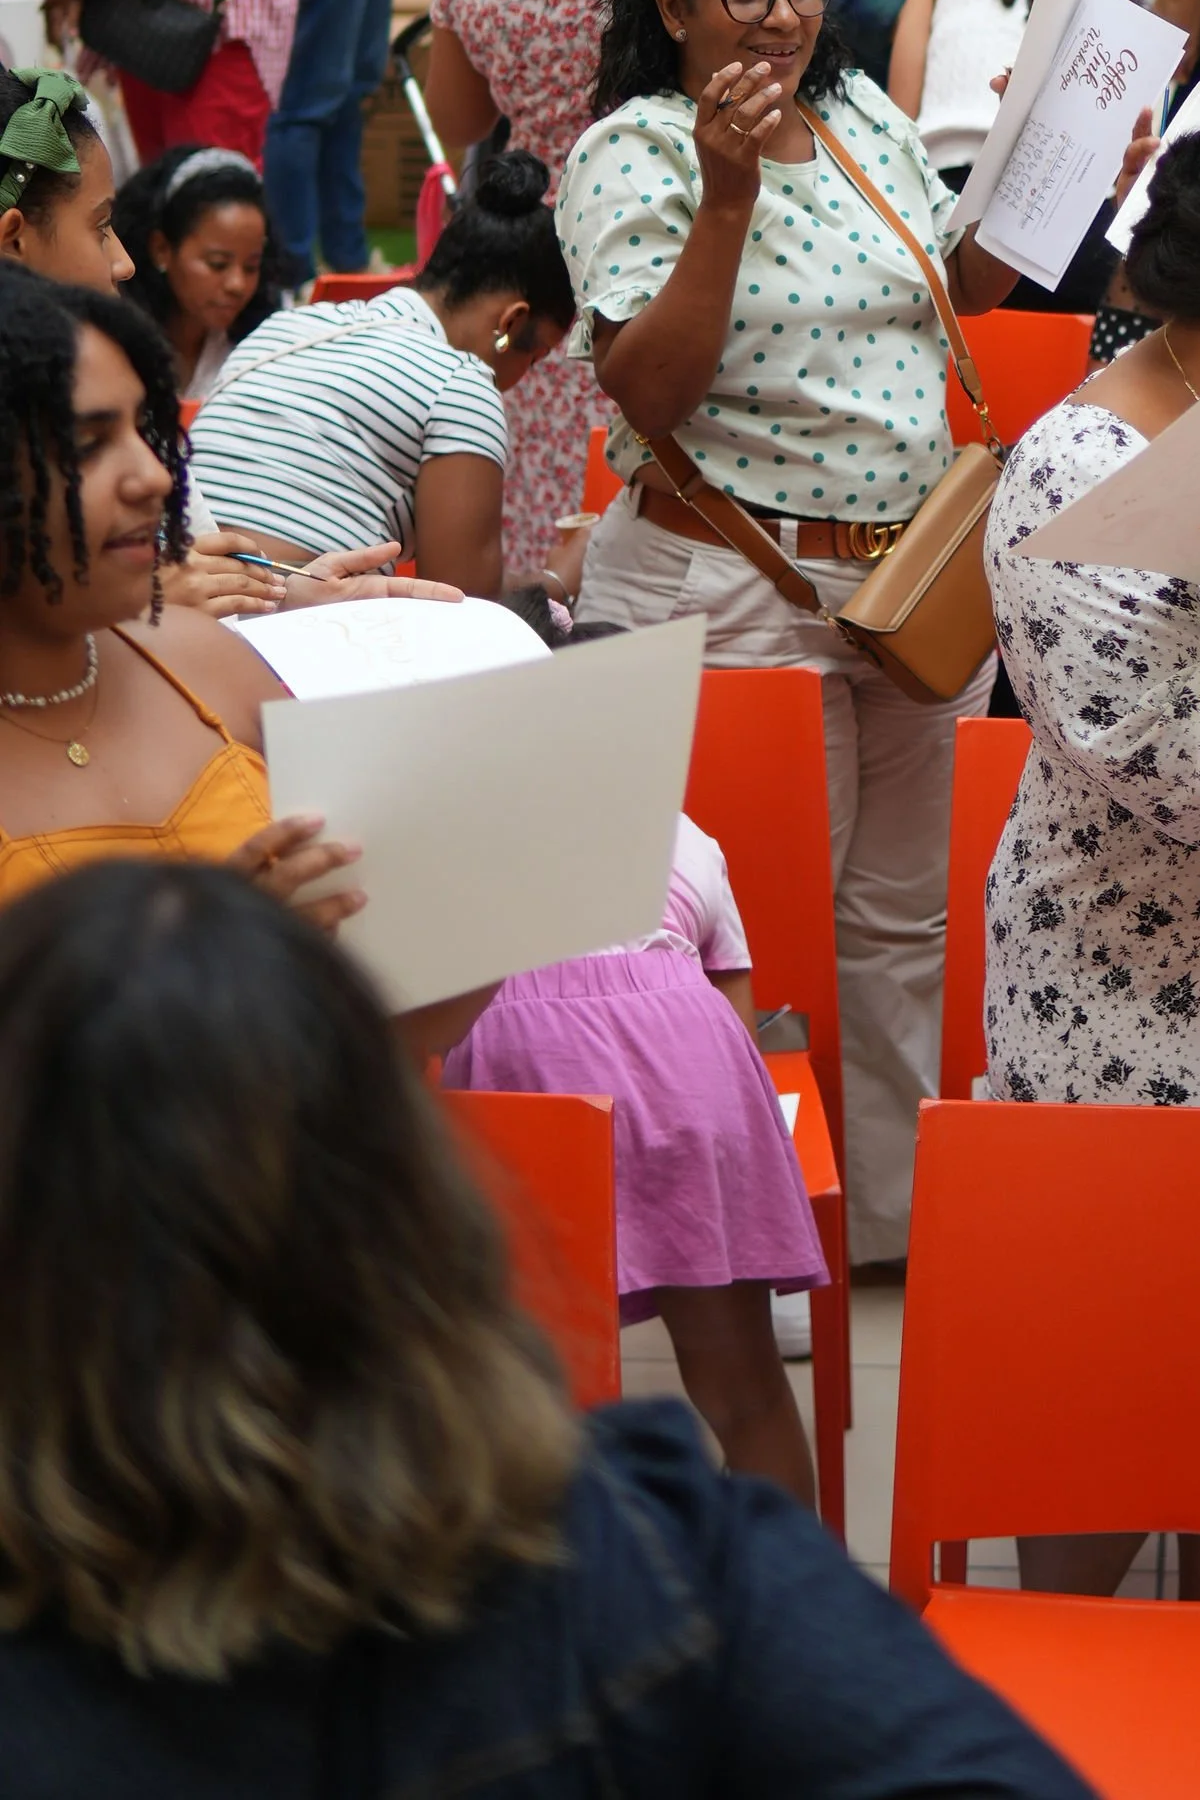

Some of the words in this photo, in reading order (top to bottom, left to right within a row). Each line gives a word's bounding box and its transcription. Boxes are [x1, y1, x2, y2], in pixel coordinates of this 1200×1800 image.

[1059, 26, 1102, 93] Workshop
[1078, 42, 1112, 90] Ink
[1096, 48, 1139, 111] Coffee
